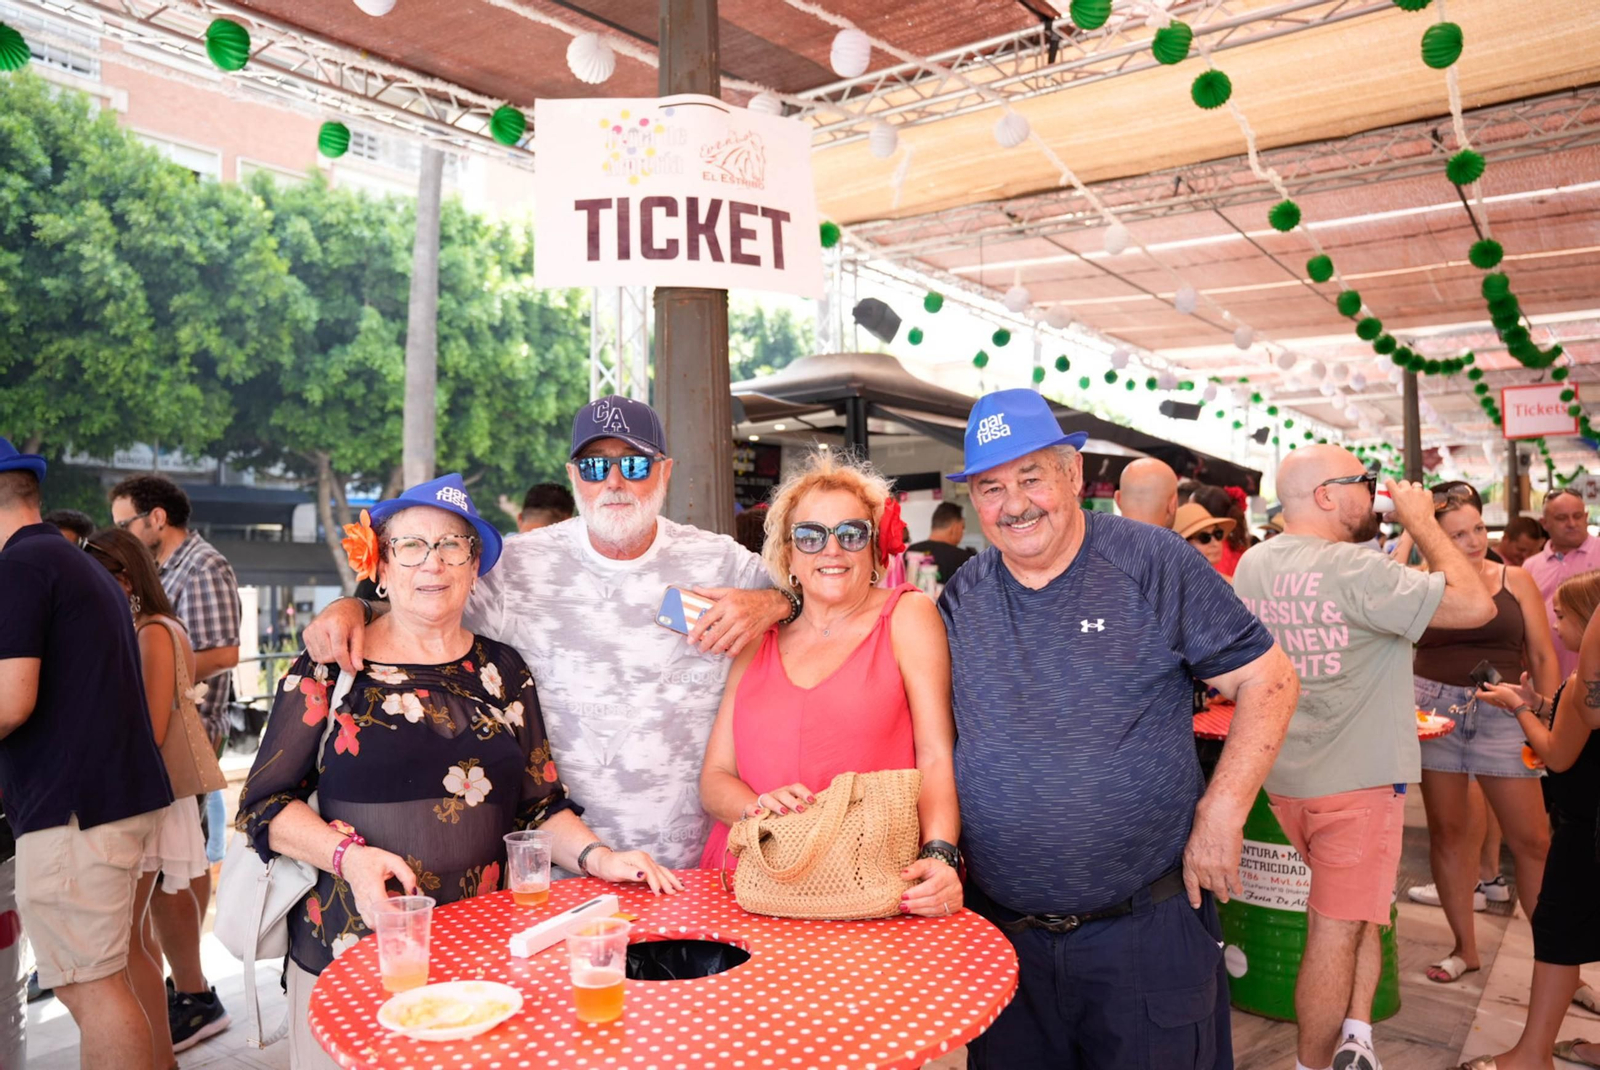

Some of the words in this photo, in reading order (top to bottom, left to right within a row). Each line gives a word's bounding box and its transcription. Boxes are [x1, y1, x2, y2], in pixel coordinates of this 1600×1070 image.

[574, 196, 791, 271] TICKET
[1513, 401, 1567, 418] Tickets
[976, 424, 1012, 446] fusa
[979, 413, 1005, 434] gar
[1273, 572, 1323, 597] LIVE
[1320, 600, 1346, 624] &
[1284, 625, 1349, 652] NEW
[1290, 652, 1341, 677] HTS
[1242, 845, 1279, 860] NTURA
[1239, 858, 1306, 876] ECTRICIDAD
